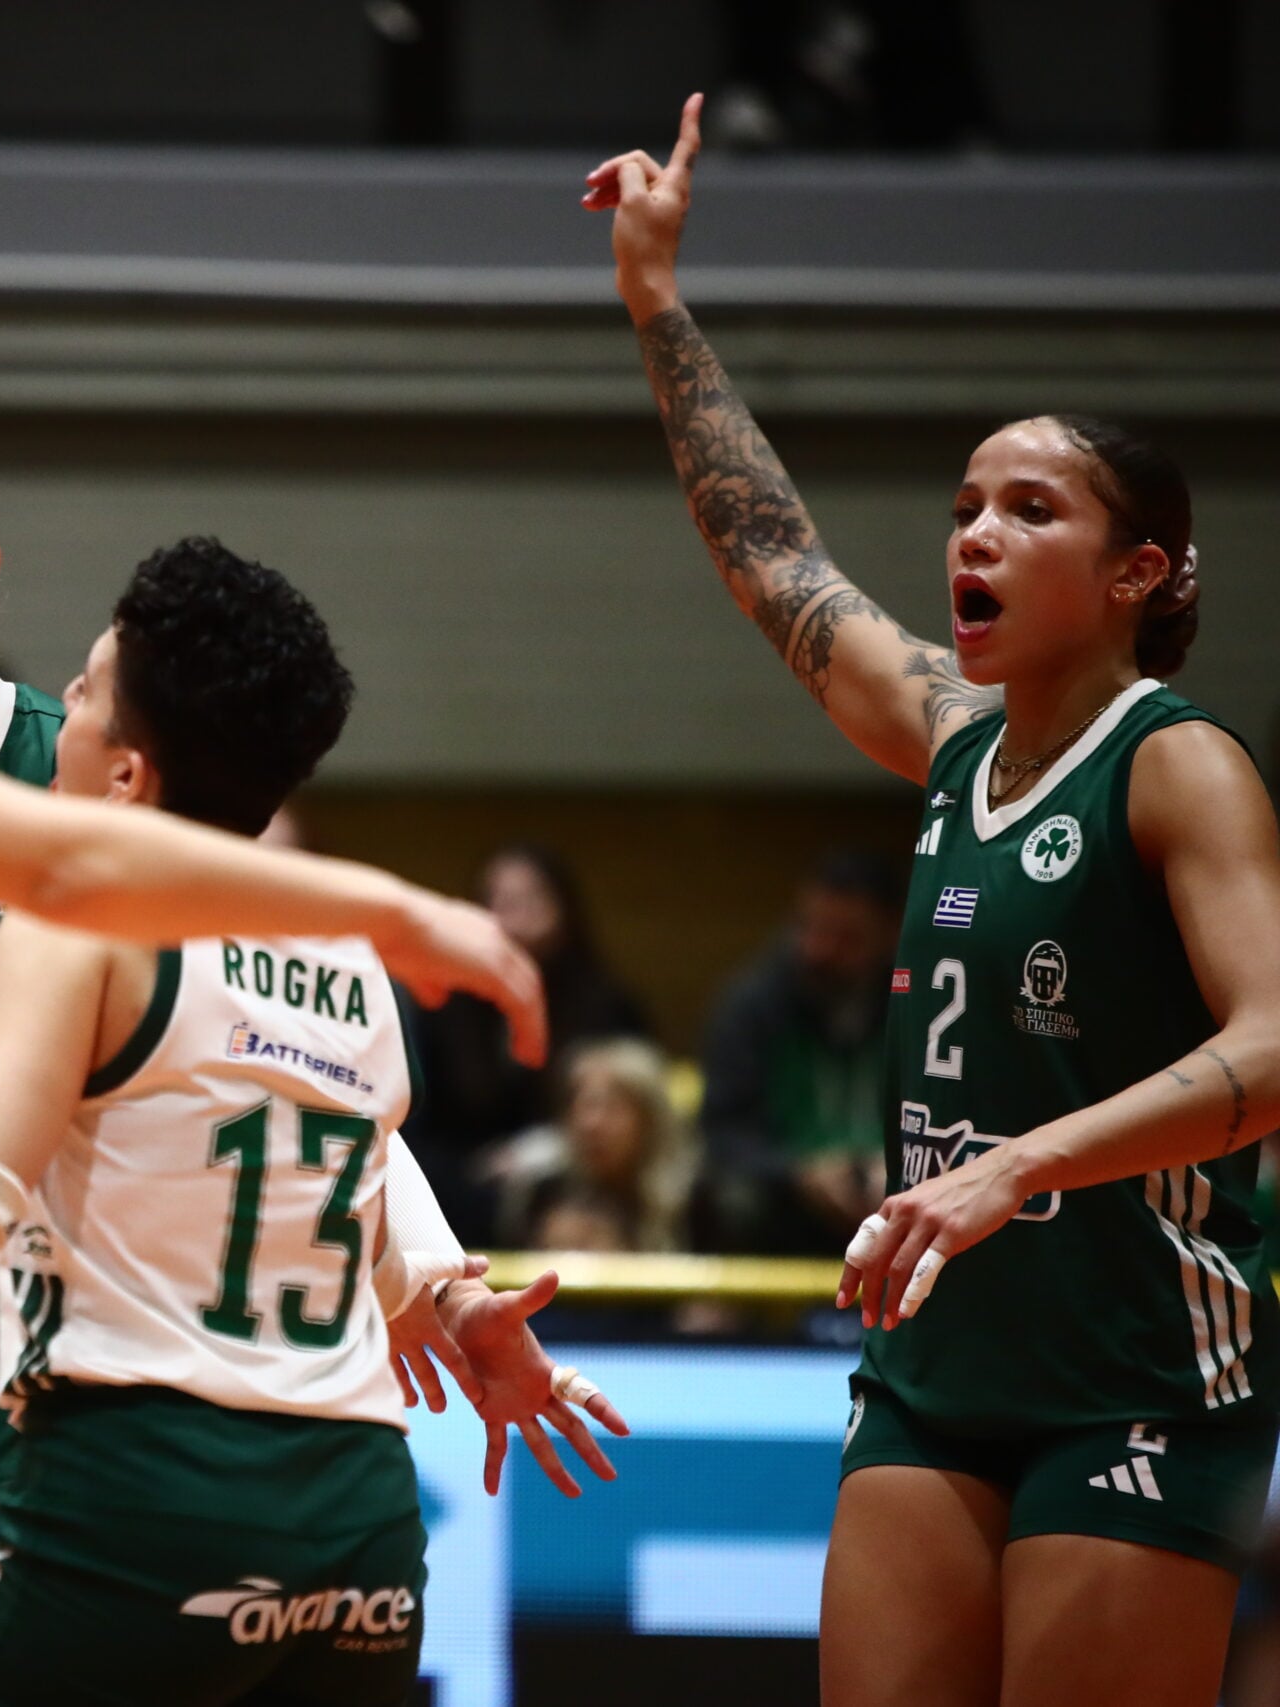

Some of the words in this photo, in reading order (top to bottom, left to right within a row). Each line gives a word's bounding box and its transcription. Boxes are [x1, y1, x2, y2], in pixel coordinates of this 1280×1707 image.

[1035, 869, 1054, 879] 1908
[222, 938, 369, 1028] ROGKA
[924, 958, 967, 1080] 2
[1026, 1008, 1074, 1026] ΣΠΙΤΙΚΟ
[1027, 1019, 1080, 1038] ΓΙΑΣΕΜΗ
[197, 1095, 381, 1353] 13
[230, 1587, 416, 1644] avance
